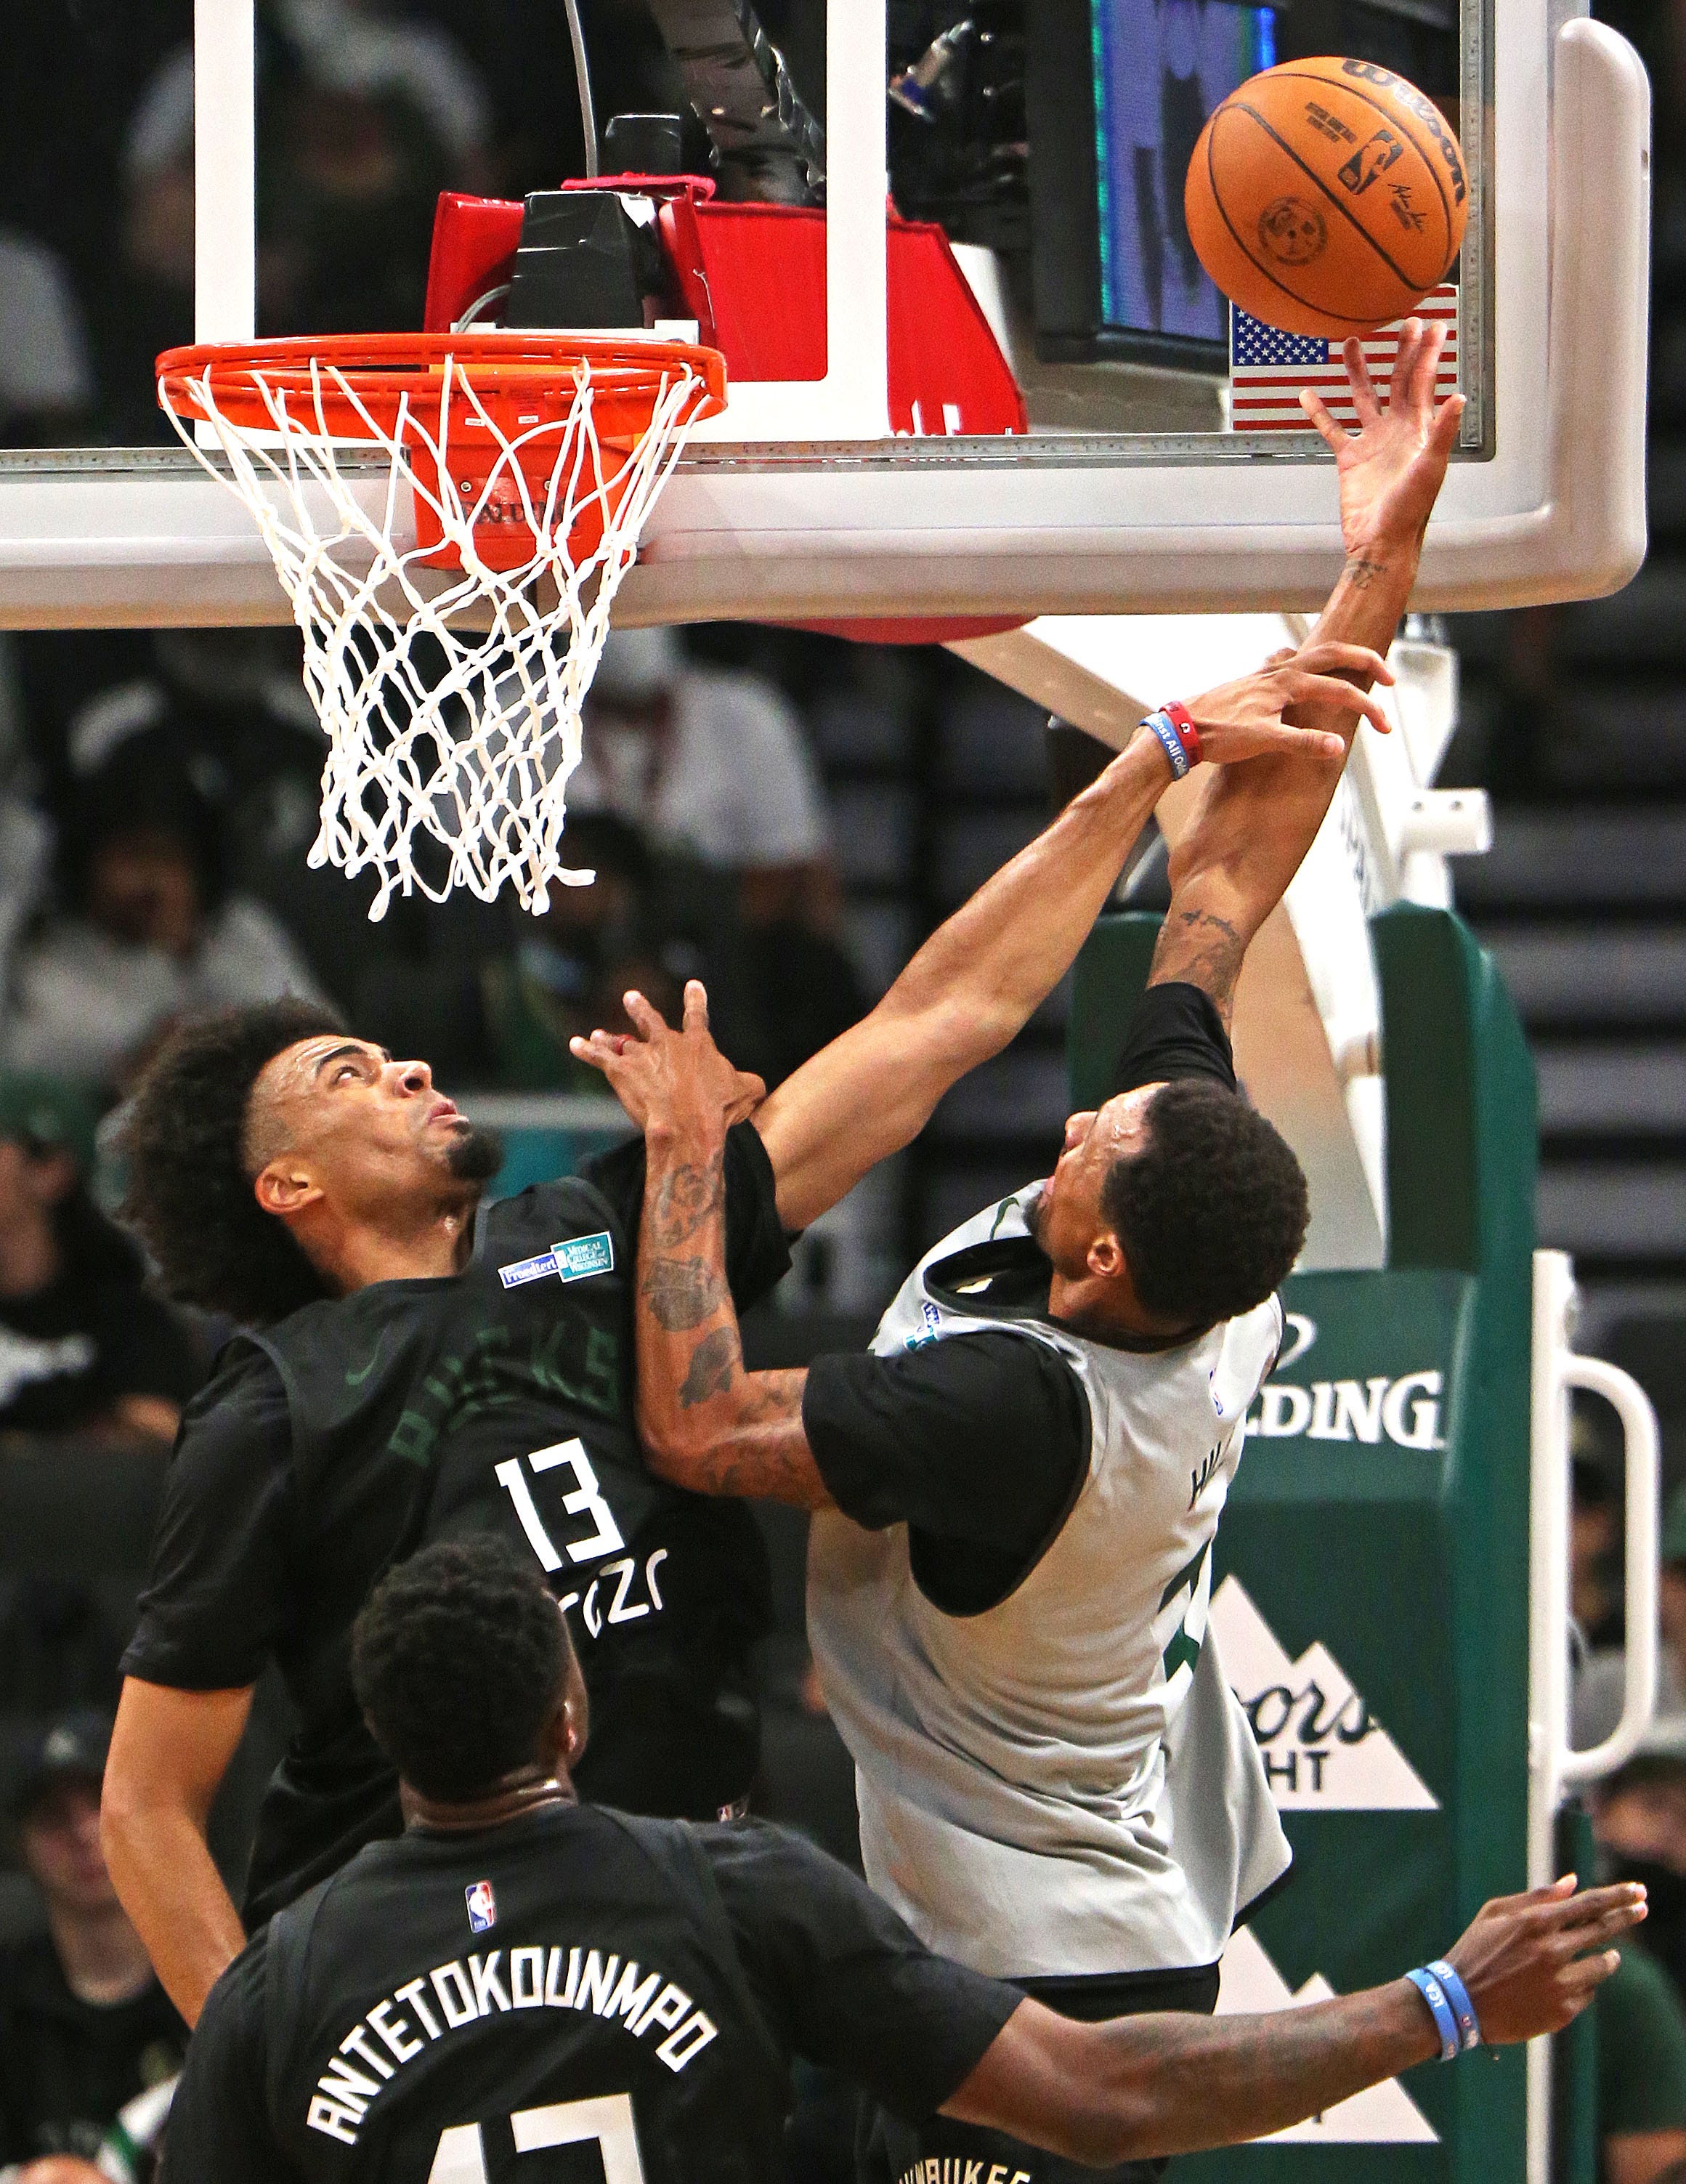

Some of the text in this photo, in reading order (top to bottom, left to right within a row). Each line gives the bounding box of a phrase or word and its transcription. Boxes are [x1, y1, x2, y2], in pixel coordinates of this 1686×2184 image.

[1166, 740, 1181, 757] All
[1245, 1370, 1443, 1450] DING
[495, 1437, 625, 1572] 13
[307, 1946, 718, 2145] ANTETOKOUNMPO
